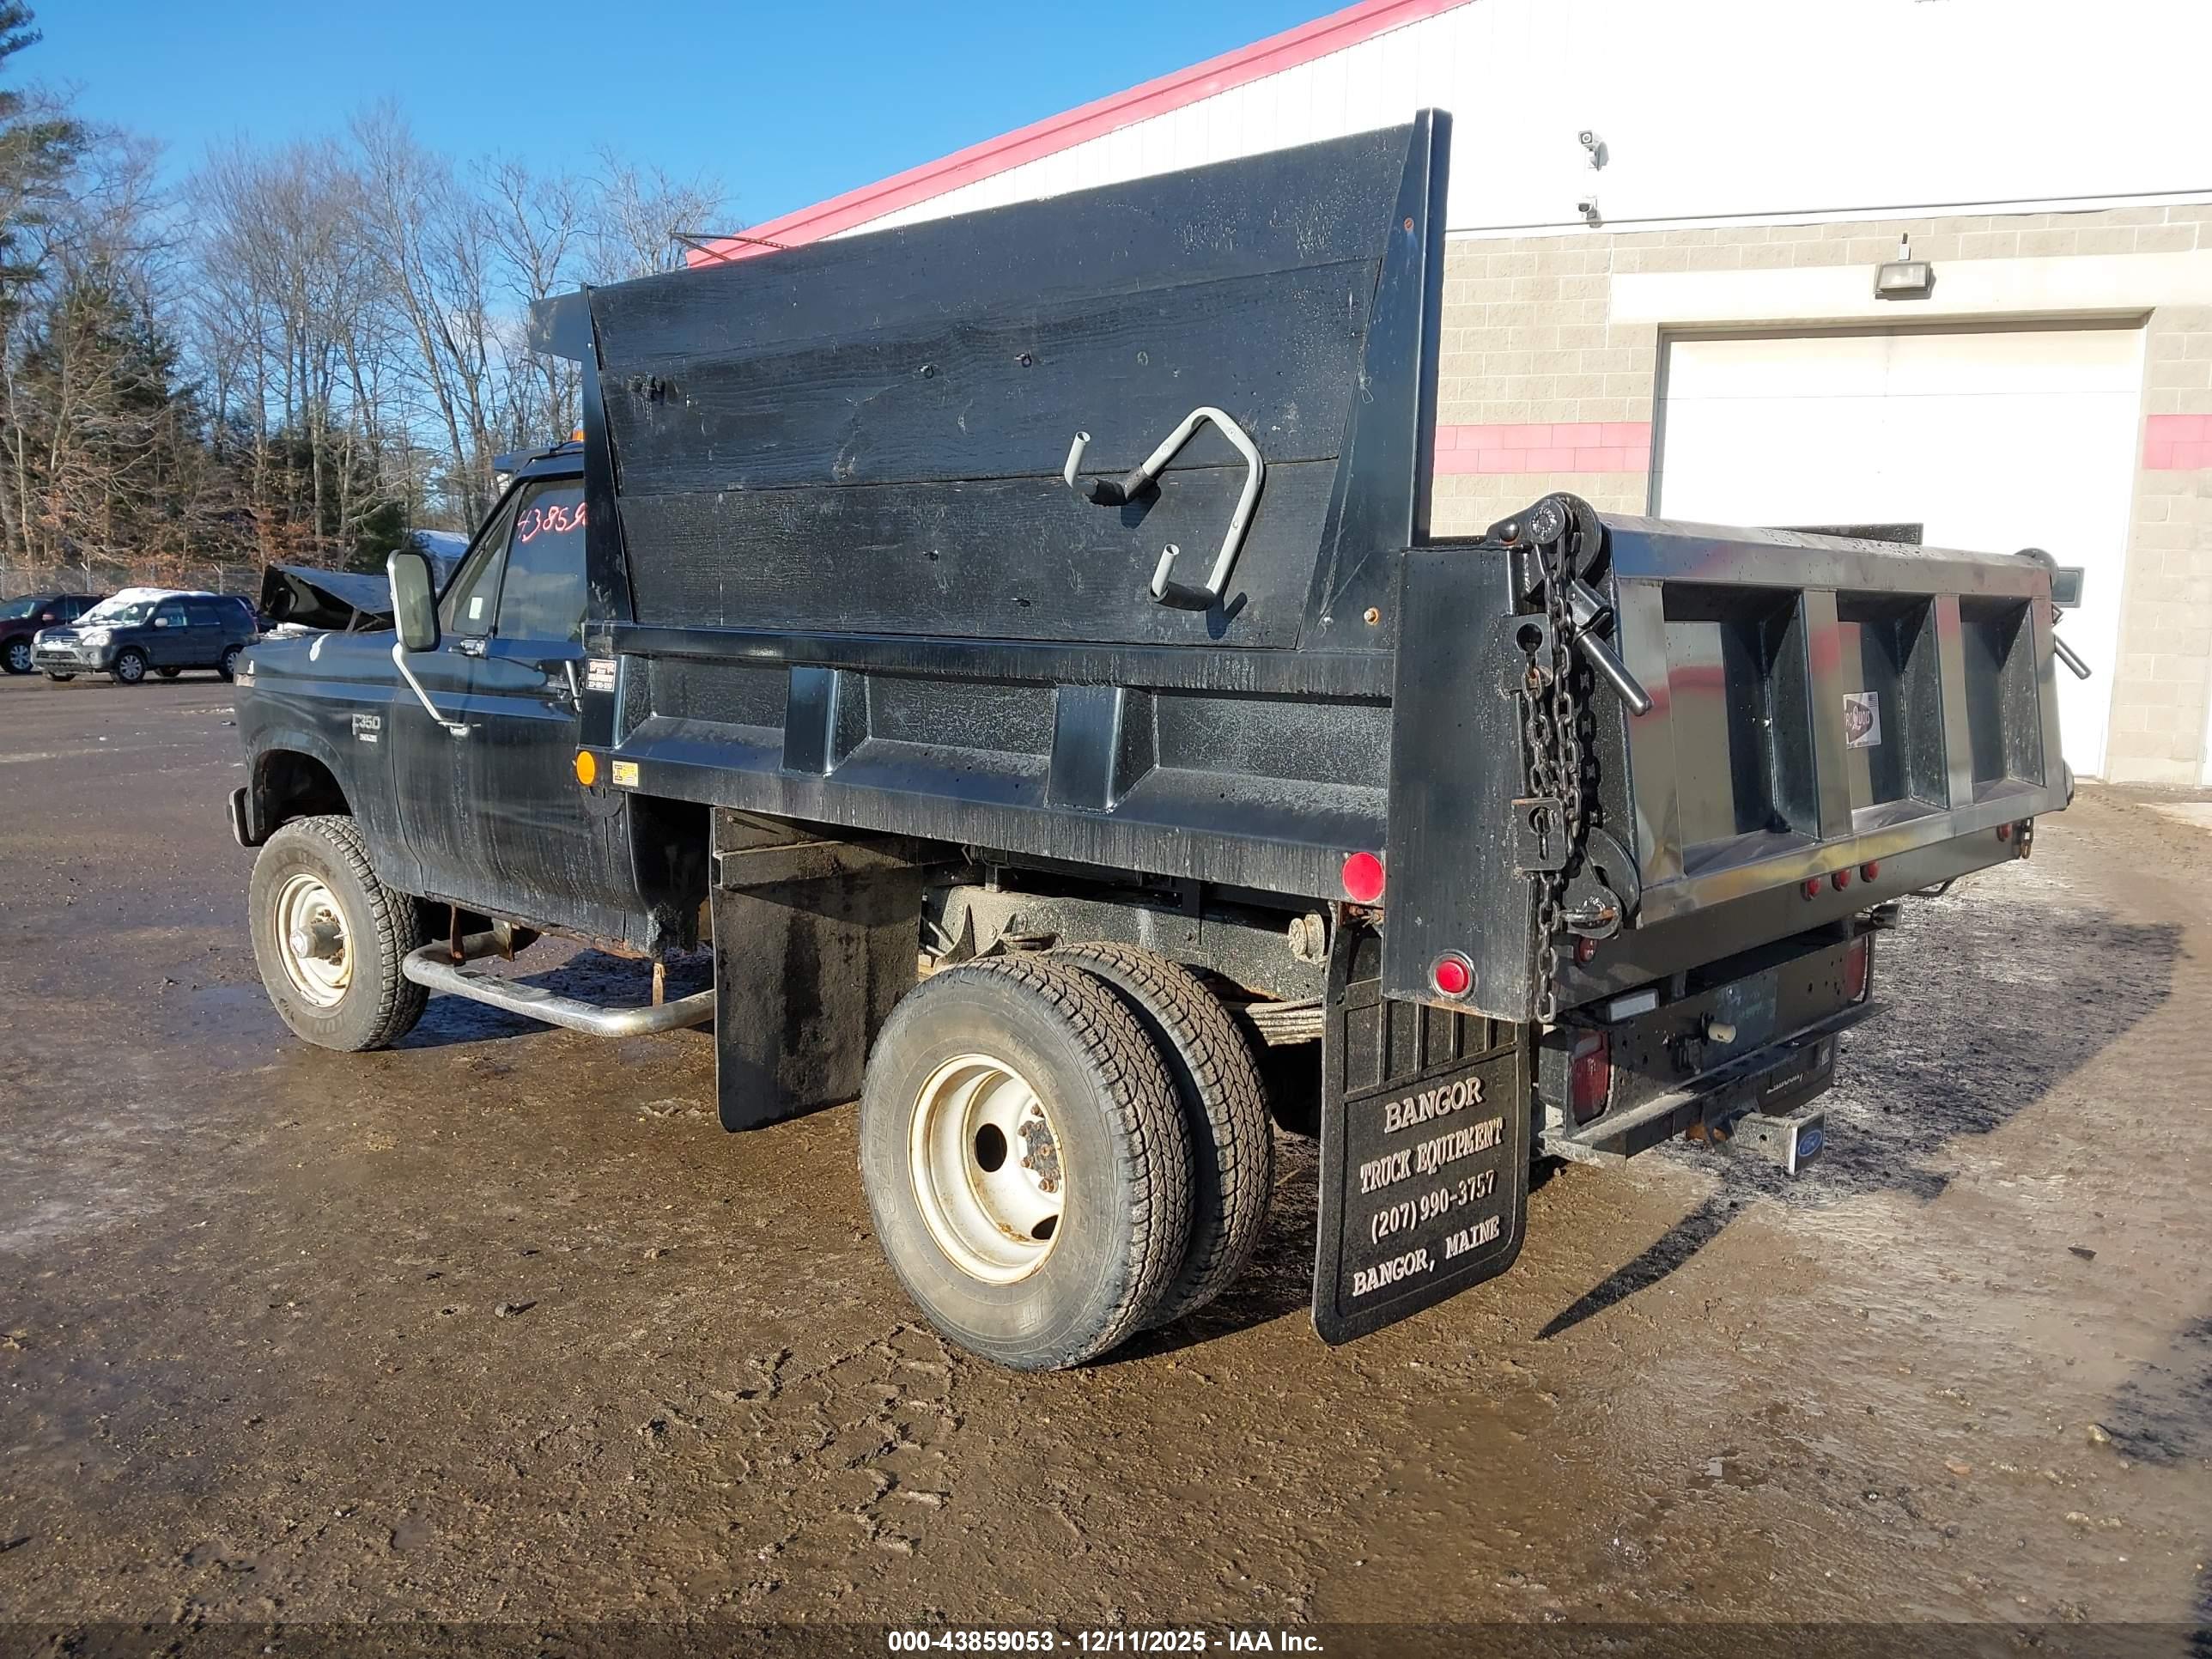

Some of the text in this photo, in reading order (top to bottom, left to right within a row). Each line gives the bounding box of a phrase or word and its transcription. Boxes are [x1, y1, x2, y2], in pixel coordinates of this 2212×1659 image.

[517, 502, 587, 542] 43859
[1384, 1077, 1483, 1133] BANGOR
[1360, 1116, 1504, 1194] TRUCK EQUIPMENT
[1352, 1215, 1500, 1297] BANGOR, MAINE
